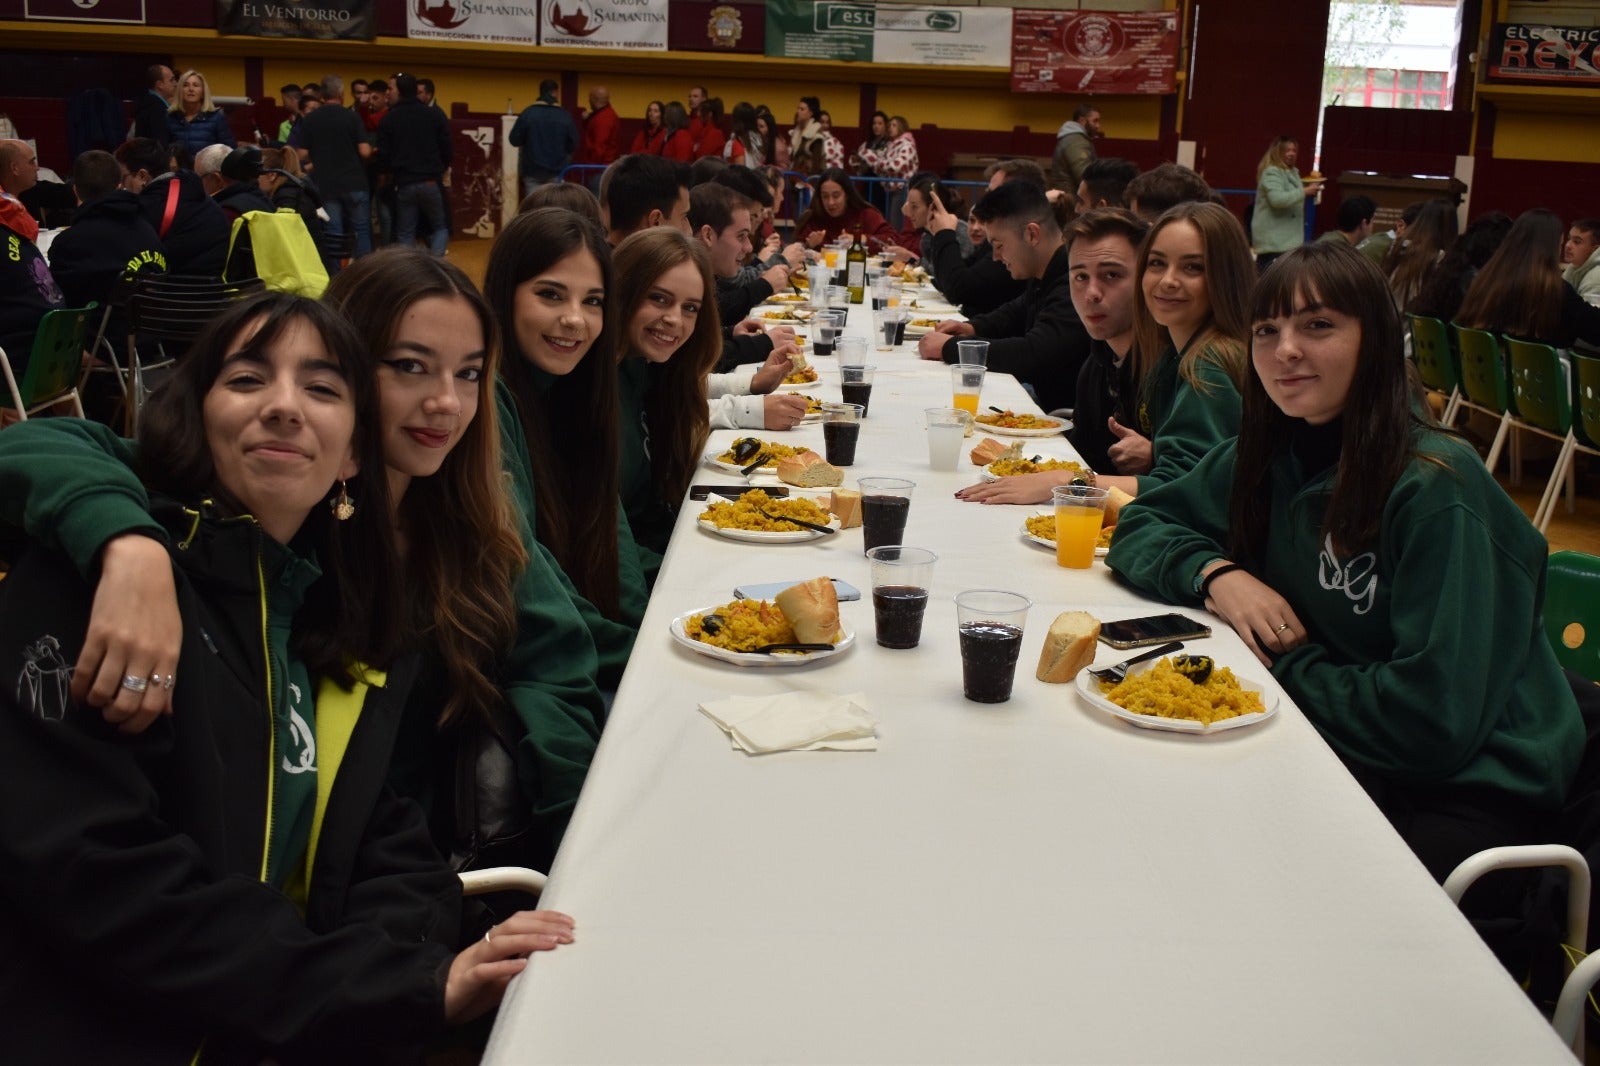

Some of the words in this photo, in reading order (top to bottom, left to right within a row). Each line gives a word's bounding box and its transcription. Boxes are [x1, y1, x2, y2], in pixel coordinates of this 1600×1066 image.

[242, 3, 260, 17] EL
[264, 4, 351, 22] VENTORRO
[461, 0, 535, 17] SALMANTINA
[594, 8, 667, 24] SALMANTINA
[842, 10, 873, 25] est
[877, 17, 921, 28] ingenieros
[409, 28, 481, 40] CONSTRUCCIONES
[490, 35, 533, 43] REFORMAS
[544, 37, 614, 48] CONSTRUCCIONES
[623, 41, 665, 49] REFORMAS
[140, 249, 154, 263] EL
